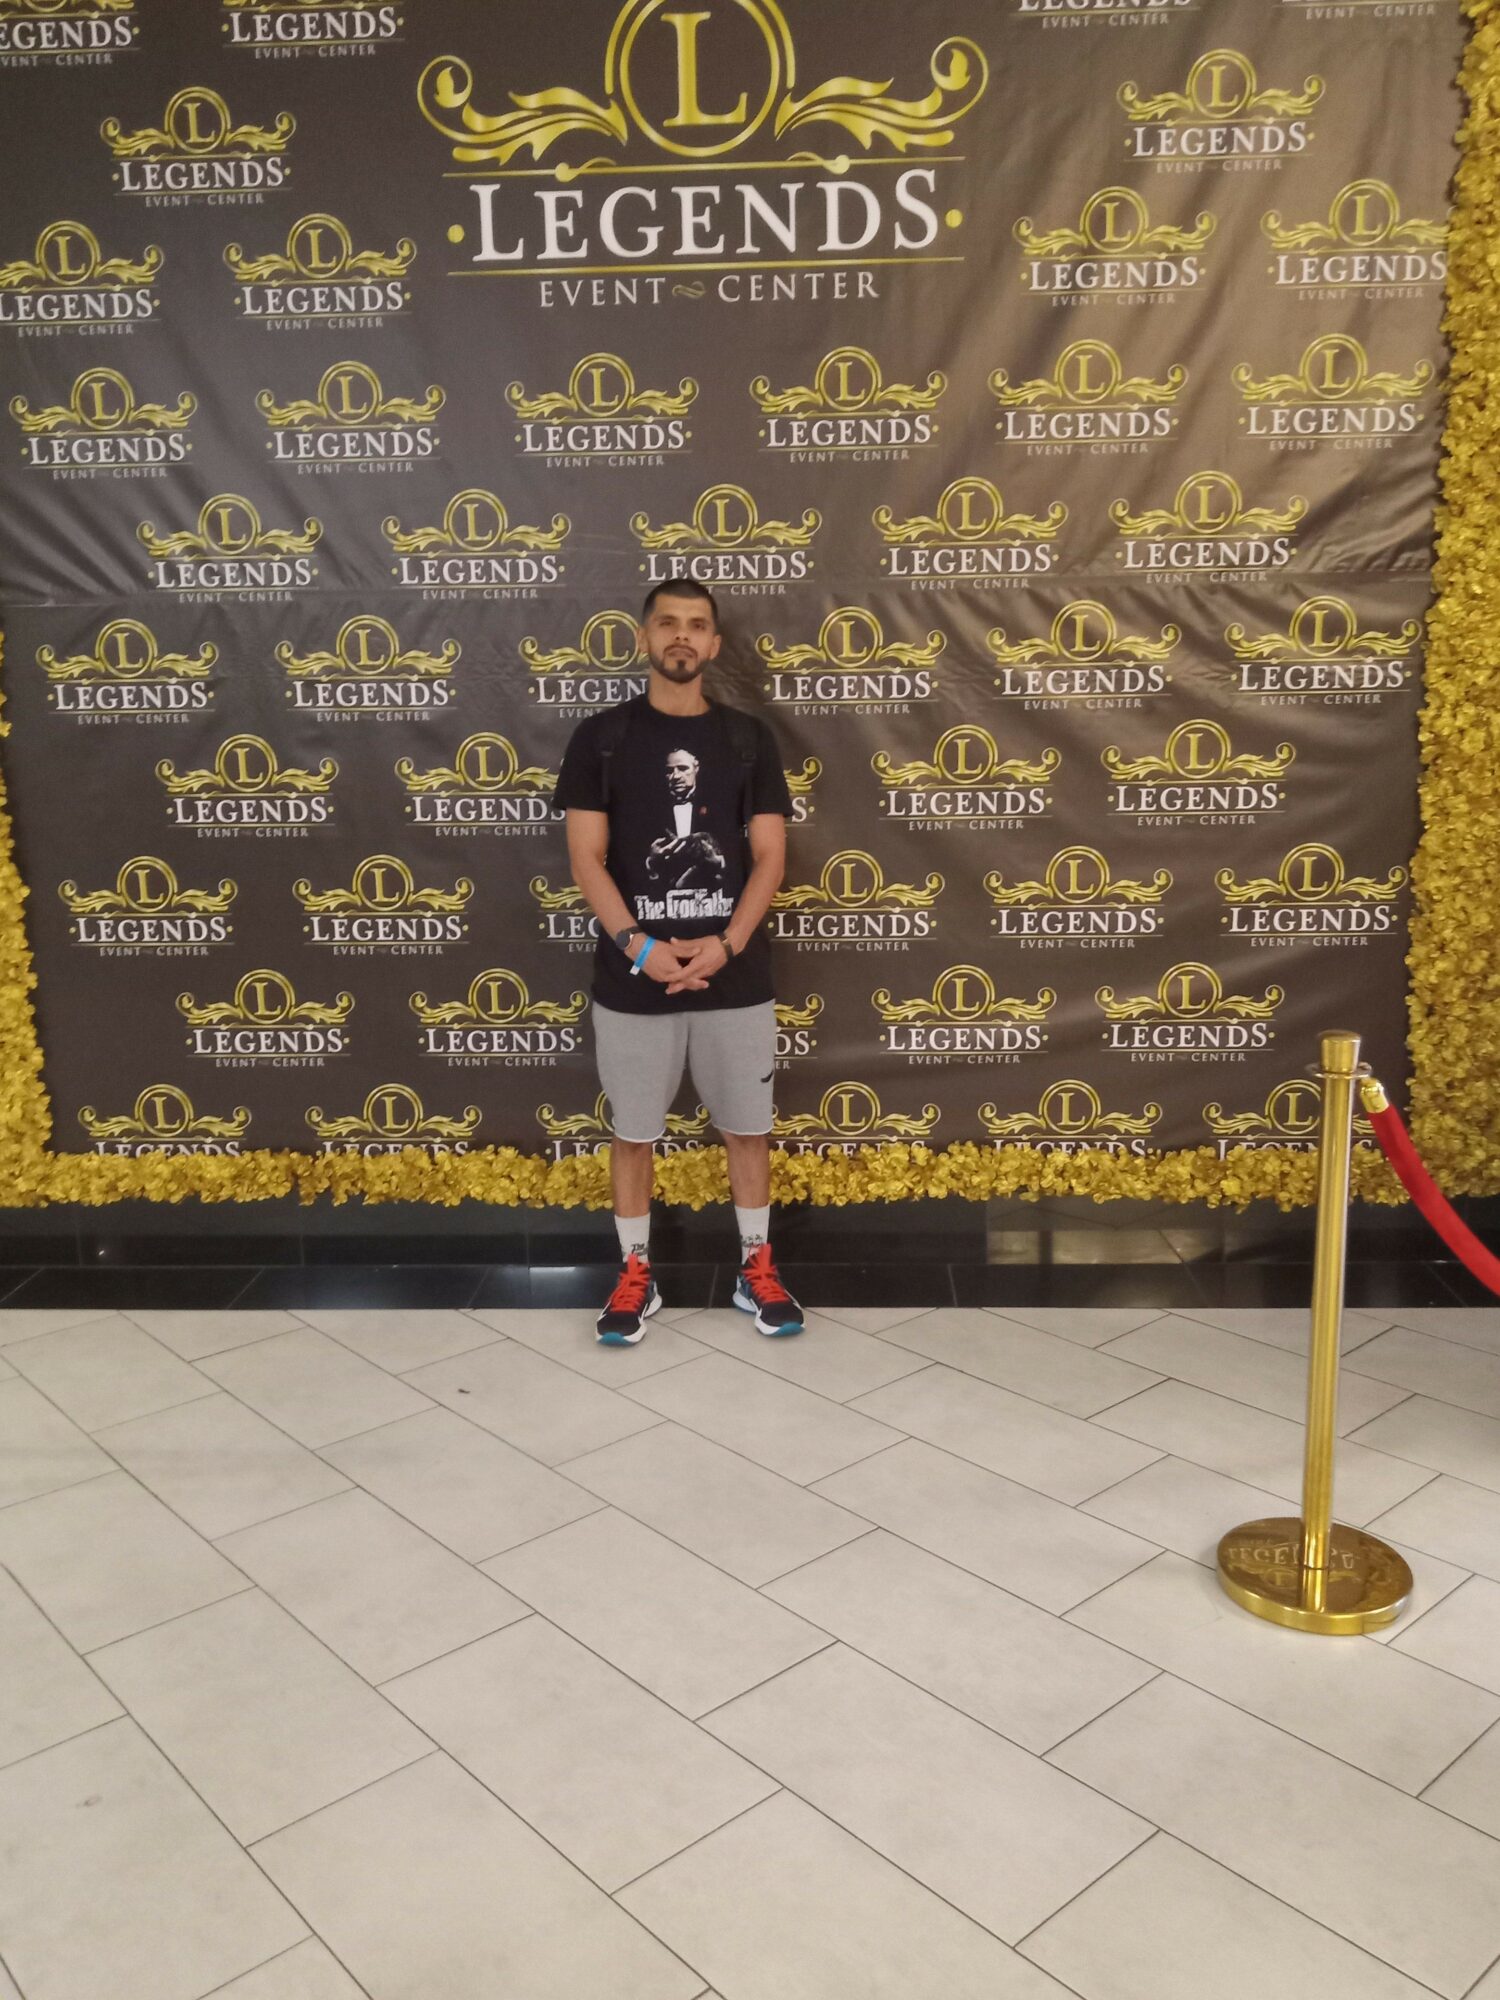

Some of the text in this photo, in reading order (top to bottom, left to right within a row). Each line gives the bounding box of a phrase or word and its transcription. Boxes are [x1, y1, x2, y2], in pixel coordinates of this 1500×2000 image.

[0, 16, 132, 50] EGENDS
[230, 7, 395, 42] LEGENDS
[1043, 13, 1168, 28] EVENT CENTER
[57, 54, 112, 66] CENTER
[256, 44, 375, 59] EVENT CENTER
[661, 11, 747, 127] L
[1208, 65, 1238, 107] L
[185, 102, 214, 143] L
[1133, 121, 1305, 157] LEGENDS
[120, 157, 282, 191] LEGENDS
[146, 193, 263, 207] EVENT CENTER
[470, 169, 938, 262] LEGENDS
[1351, 195, 1381, 236] L
[1102, 202, 1131, 243] L
[56, 235, 85, 275] L
[308, 228, 336, 268] L
[1029, 257, 1197, 290] LEGENDS
[1276, 250, 1447, 285] LEGENDS
[0, 289, 151, 321] LEGENDS
[242, 282, 402, 315] LEGENDS
[540, 272, 879, 308] EVENT CENTER
[19, 324, 133, 337] EVENT CENTER
[267, 317, 383, 330] EVENT CENTER
[837, 361, 865, 401] L
[1076, 354, 1104, 394] L
[1321, 349, 1350, 389] L
[91, 382, 119, 420] L
[339, 375, 366, 414] L
[590, 368, 618, 407] L
[767, 415, 929, 447] LEGENDS
[1004, 408, 1169, 440] LEGENDS
[1247, 403, 1415, 435] LEGENDS
[28, 433, 184, 465] LEGENDS
[273, 428, 431, 459] LEGENDS
[523, 420, 683, 452] LEGENDS
[298, 462, 413, 474] EVENT CENTER
[547, 455, 663, 467] EVENT CENTER
[790, 450, 909, 463] EVENT CENTER
[54, 468, 167, 480] EVENT CENTER
[715, 499, 741, 537] L
[959, 491, 986, 530] L
[1196, 485, 1225, 523] L
[218, 508, 246, 545] L
[464, 503, 492, 541] L
[647, 551, 805, 581] LEGENDS
[888, 544, 1050, 575] LEGENDS
[1124, 537, 1289, 568] LEGENDS
[155, 558, 310, 588] LEGENDS
[399, 555, 556, 584] LEGENDS
[911, 578, 1029, 590] EVENT CENTER
[1147, 572, 1266, 584] EVENT CENTER
[180, 592, 292, 603] EVENT CENTER
[423, 589, 538, 600] EVENT CENTER
[732, 585, 785, 596] CENTER
[602, 624, 628, 661] L
[840, 621, 867, 658] L
[1072, 614, 1100, 652] L
[1311, 609, 1339, 647] L
[115, 632, 142, 668] L
[357, 629, 384, 665] L
[536, 676, 648, 703] LEGEN
[772, 671, 929, 701] LEGENDS
[1002, 665, 1163, 695] LEGENDS
[1239, 660, 1403, 691] LEGENDS
[54, 682, 206, 710] LEGENDS
[293, 679, 447, 707] LEGENDS
[1024, 698, 1142, 710] EVENT CENTER
[1262, 694, 1380, 706] EVENT CENTER
[79, 714, 188, 724] EVENT CENTER
[318, 712, 429, 722] EVENT CENTER
[795, 704, 909, 715] EVENT CENTER
[235, 748, 262, 783] L
[476, 746, 502, 781] L
[955, 738, 982, 774] L
[1186, 733, 1214, 769] L
[173, 796, 325, 823] LEGENDS
[887, 788, 1043, 816] LEGENDS
[1115, 783, 1277, 812] LEGENDS
[198, 828, 308, 838] EVENT CENTER
[436, 827, 547, 836] EVENT CENTER
[909, 820, 1023, 831] EVENT CENTER
[1138, 815, 1255, 826] EVENT CENTER
[136, 869, 163, 903] L
[372, 868, 399, 902] L
[841, 863, 867, 898] L
[1067, 859, 1093, 894] L
[1300, 856, 1327, 891] L
[634, 895, 665, 920] The
[998, 908, 1155, 934] LEGENDS
[1229, 905, 1389, 932] LEGENDS
[76, 916, 225, 942] LEGENDS
[310, 915, 460, 941] LEGENDS
[775, 911, 928, 938] LEGENDS
[101, 947, 208, 956] EVENT CENTER
[334, 946, 443, 955] EVENT CENTER
[798, 942, 909, 952] EVENT CENTER
[1020, 939, 1134, 949] EVENT CENTER
[1251, 937, 1367, 947] EVENT CENTER
[254, 982, 280, 1015] L
[488, 981, 514, 1014] L
[953, 977, 979, 1011] L
[1178, 975, 1205, 1009] L
[193, 1028, 341, 1053] LEGENDS
[426, 1027, 574, 1052] LEGENDS
[887, 1025, 1039, 1050] LEGENDS
[1109, 1022, 1266, 1048] LEGENDS
[217, 1058, 324, 1067] EVENT CENTER
[449, 1057, 556, 1067] EVENT CENTER
[909, 1055, 1020, 1065] EVENT CENTER
[1131, 1053, 1245, 1062] EVENT CENTER
[153, 1097, 179, 1128] L
[383, 1096, 408, 1128] L
[840, 1094, 865, 1126] L
[1059, 1092, 1085, 1125] L
[1285, 1093, 1312, 1125] L
